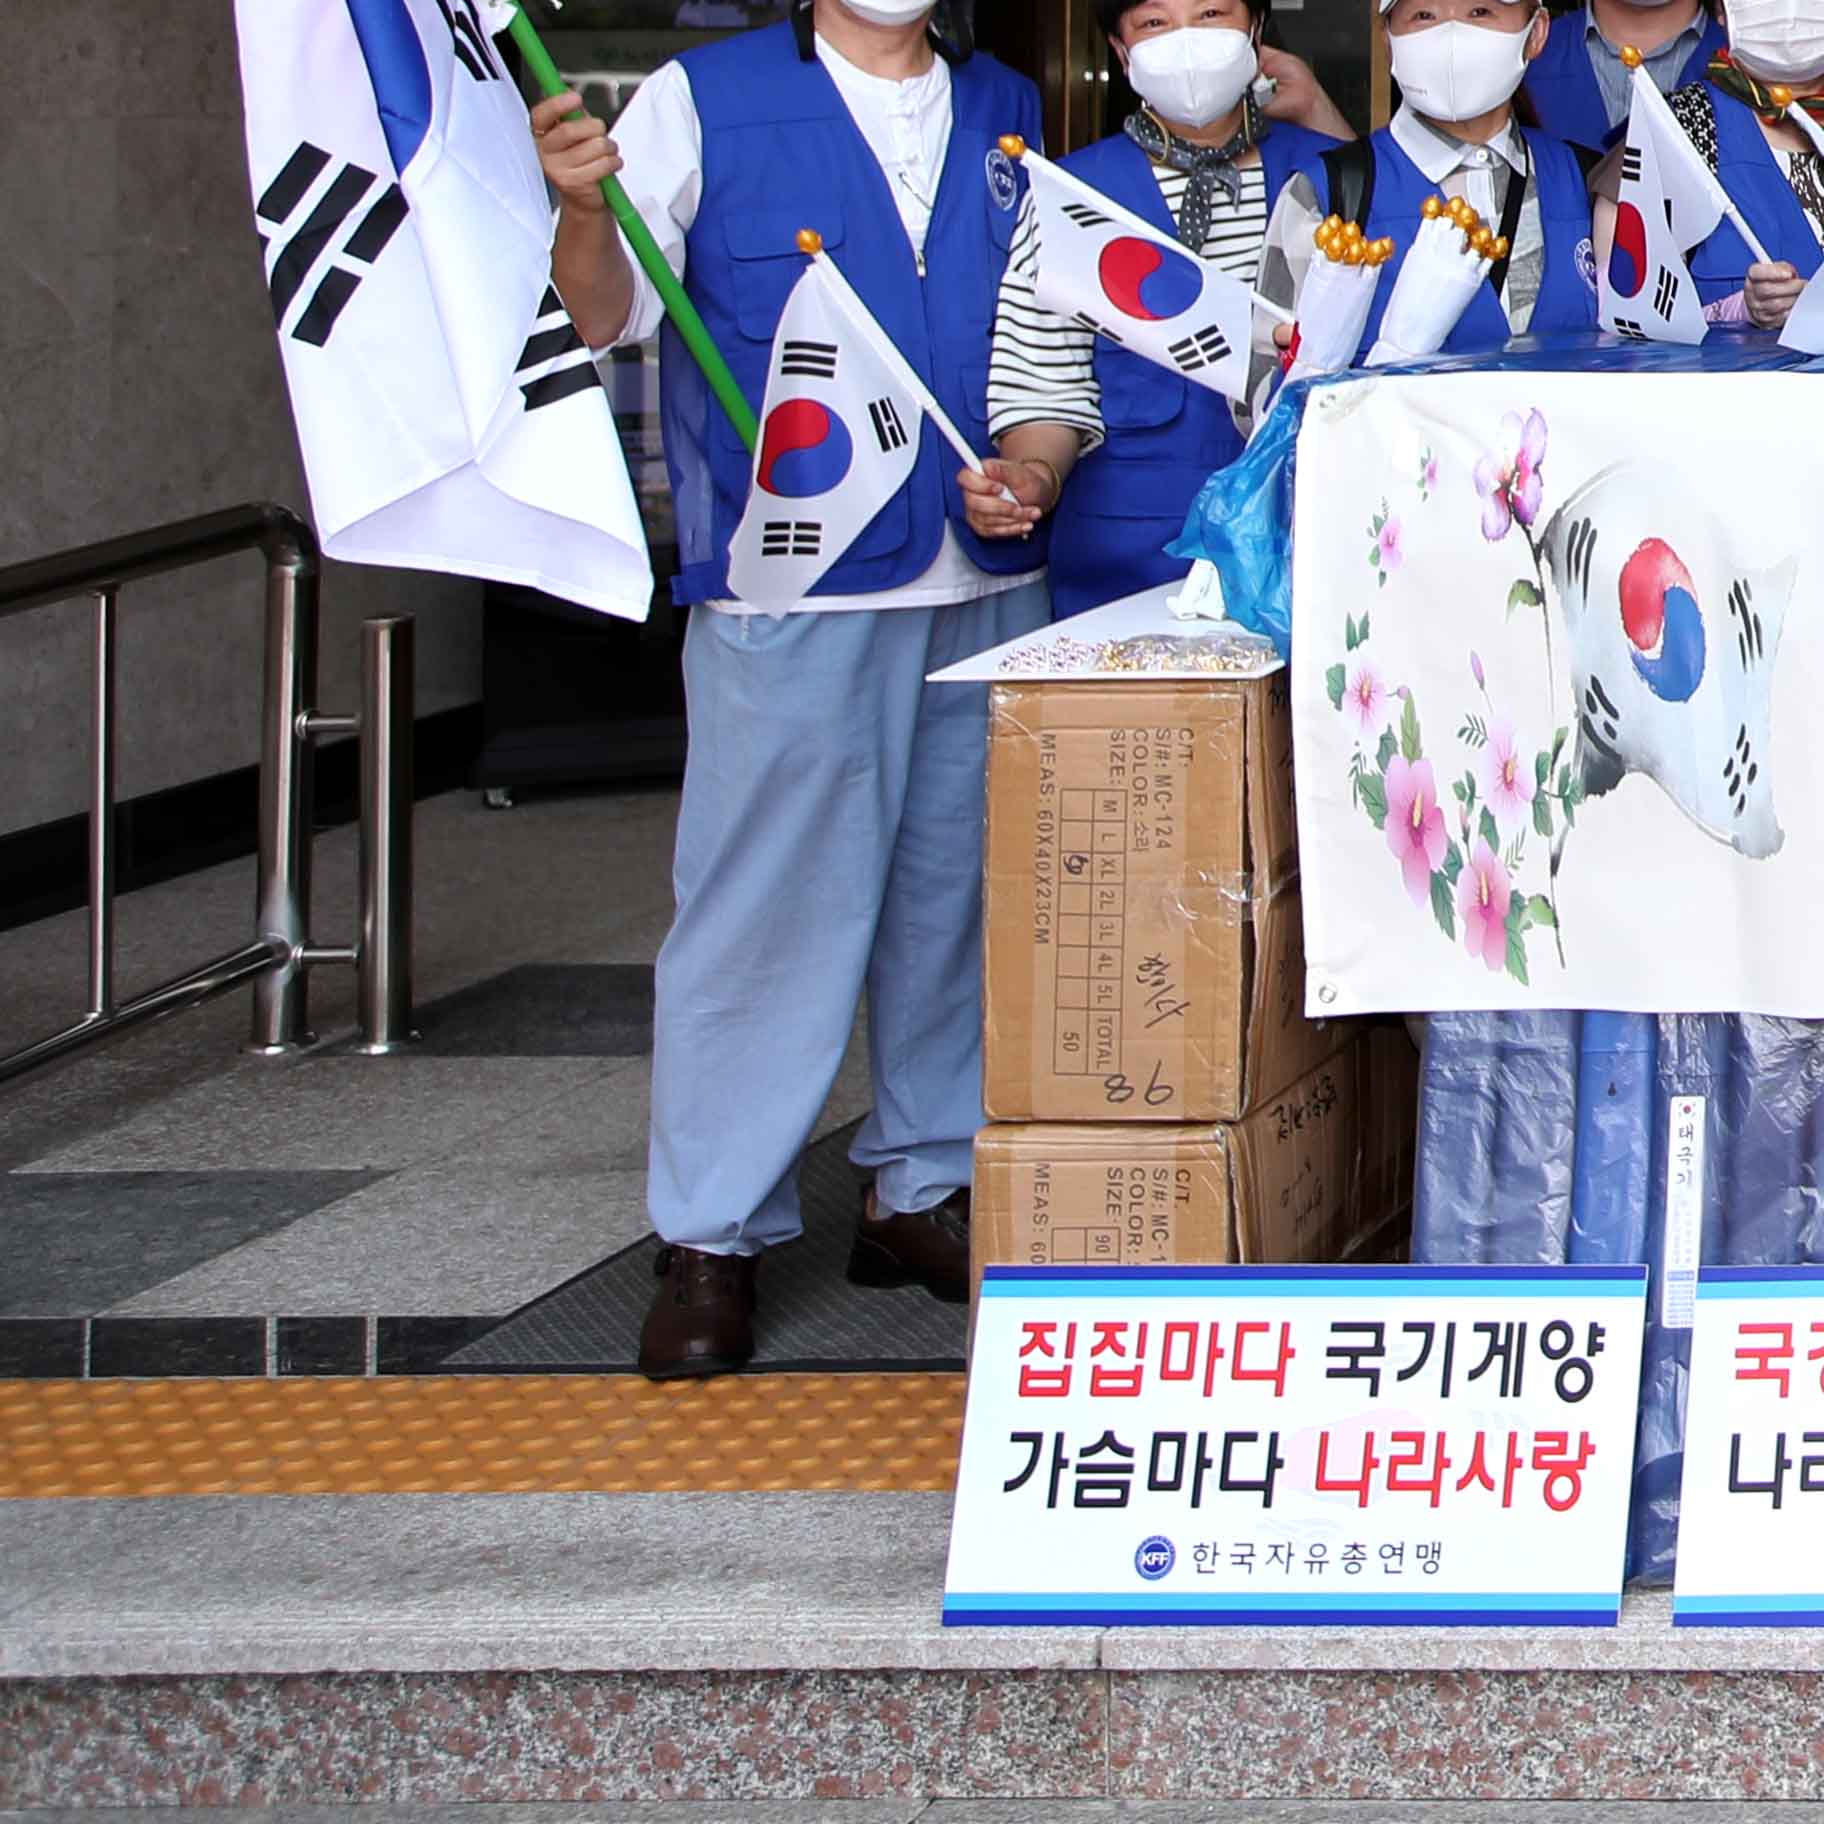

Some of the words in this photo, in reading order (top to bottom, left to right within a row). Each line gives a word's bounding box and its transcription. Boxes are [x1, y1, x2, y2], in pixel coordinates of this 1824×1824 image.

[1039, 733, 1057, 803] MEAS:
[1109, 729, 1126, 784] SIZE:
[1132, 729, 1149, 816] COLOR:
[1102, 799, 1118, 813] M
[1154, 774, 1173, 849] MC-124
[1101, 832, 1117, 844] L
[1033, 809, 1055, 944] 60X40X23CM
[1100, 857, 1116, 879] XL
[1099, 889, 1115, 910] 2L
[1099, 921, 1115, 941] 3L
[1097, 952, 1113, 973] 4L
[1097, 984, 1113, 1004] 5L
[1062, 1031, 1080, 1053] 50
[1096, 1015, 1113, 1069] TOTAL
[1676, 1122, 1695, 1187] 태극기
[1032, 1162, 1051, 1233] MEAS:
[1127, 1167, 1147, 1255] COLOR:
[1150, 1214, 1170, 1264] MC-1
[1018, 1321, 1296, 1398] 집집마다
[1325, 1320, 1606, 1403] 국기게양
[1003, 1430, 1285, 1510] 가슴마다
[1315, 1430, 1596, 1512] 나라사랑
[1192, 1541, 1442, 1575] 한국자유총연맹
